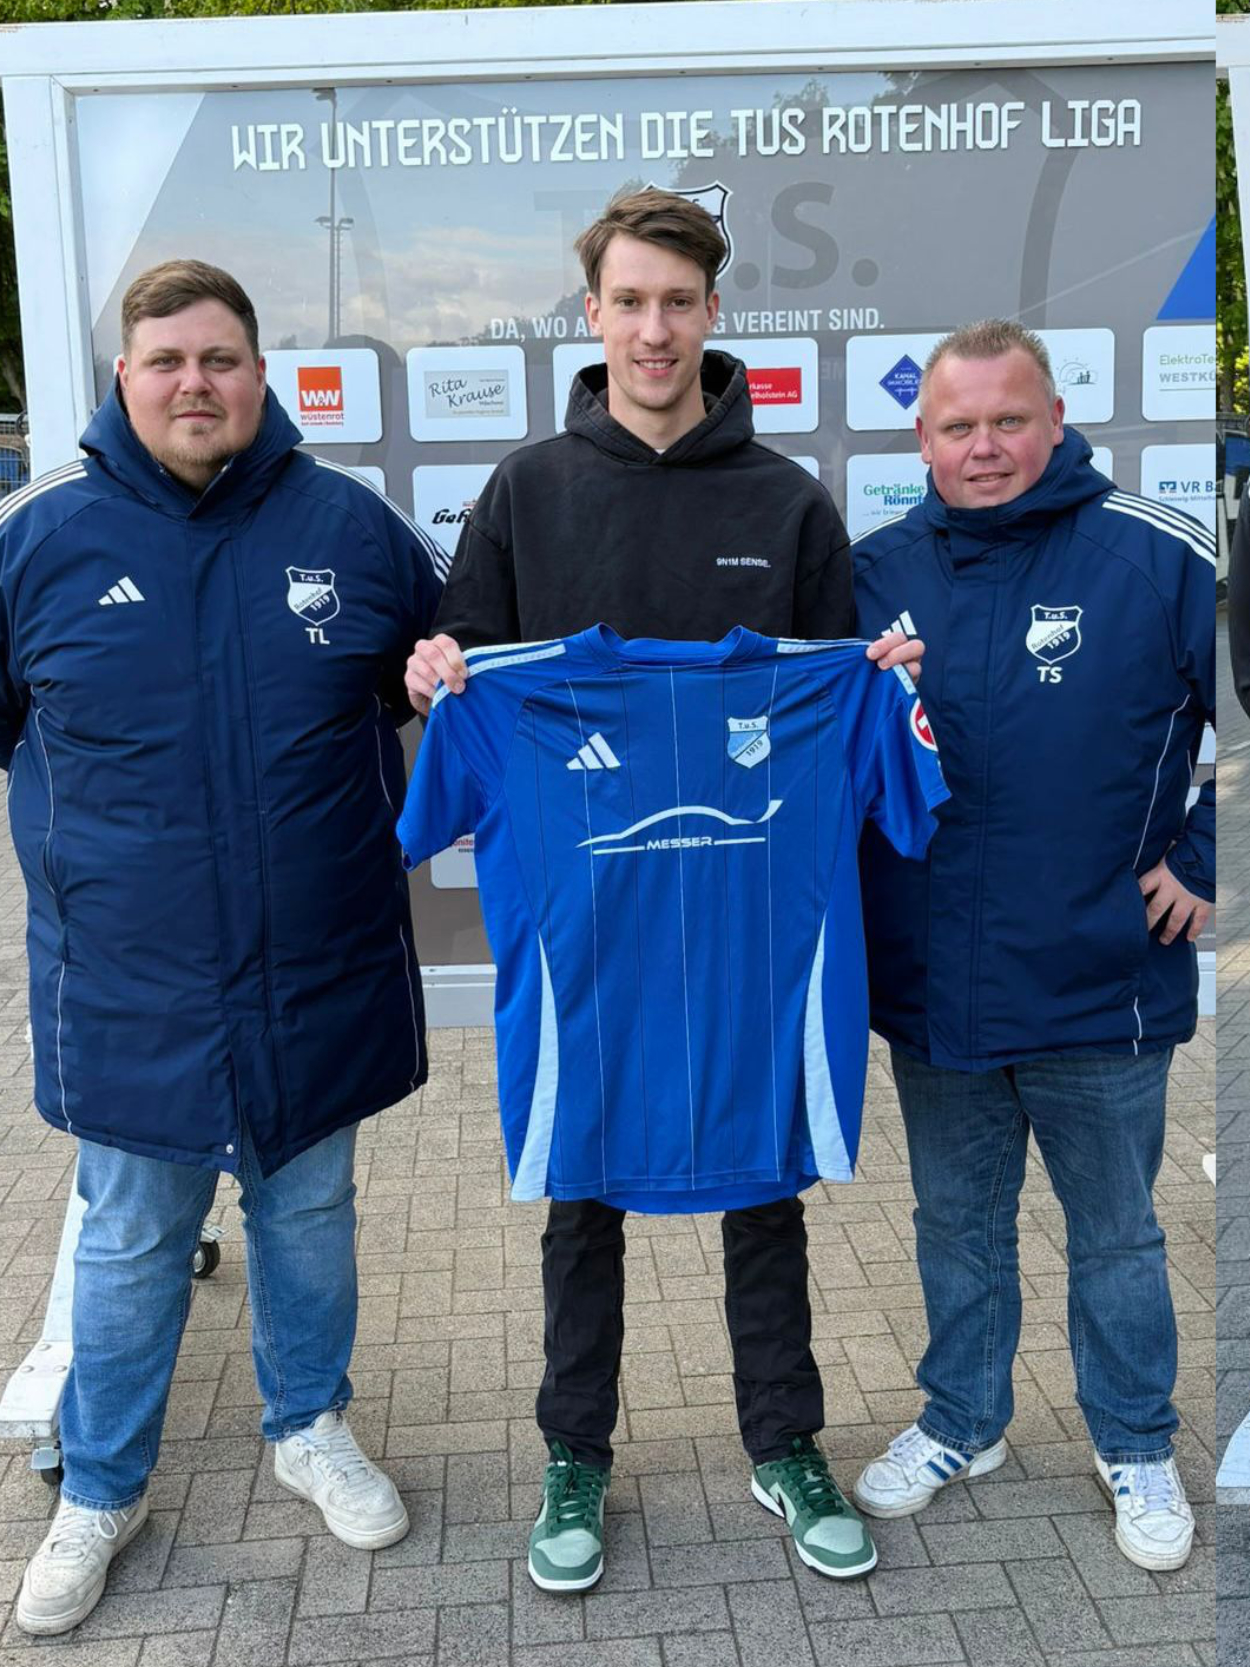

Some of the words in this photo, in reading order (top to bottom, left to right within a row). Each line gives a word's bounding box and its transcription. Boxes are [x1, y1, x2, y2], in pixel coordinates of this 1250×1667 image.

[231, 123, 306, 171] WIR
[320, 107, 625, 168] UNTERSTÜTZEN
[641, 110, 714, 159] DIE
[731, 108, 807, 157] TUS
[821, 101, 1026, 154] ROTENHOF
[1041, 98, 1142, 148] LIGA
[733, 309, 822, 334] VEREINT
[829, 307, 886, 332] SIND.
[490, 317, 526, 343] DA,
[532, 316, 568, 339] WO
[1159, 353, 1216, 366] ElektroTe
[1159, 370, 1216, 383] WESTKÜ
[428, 379, 467, 399] Rita
[446, 383, 505, 409] Krause
[863, 484, 925, 496] Getränke
[1180, 481, 1201, 493] VR
[310, 594, 330, 611] 1919
[305, 627, 330, 645] TL
[1047, 631, 1071, 649] 1919
[1036, 666, 1063, 683] TS
[746, 740, 764, 757] 1919
[646, 836, 713, 851] MESSER
